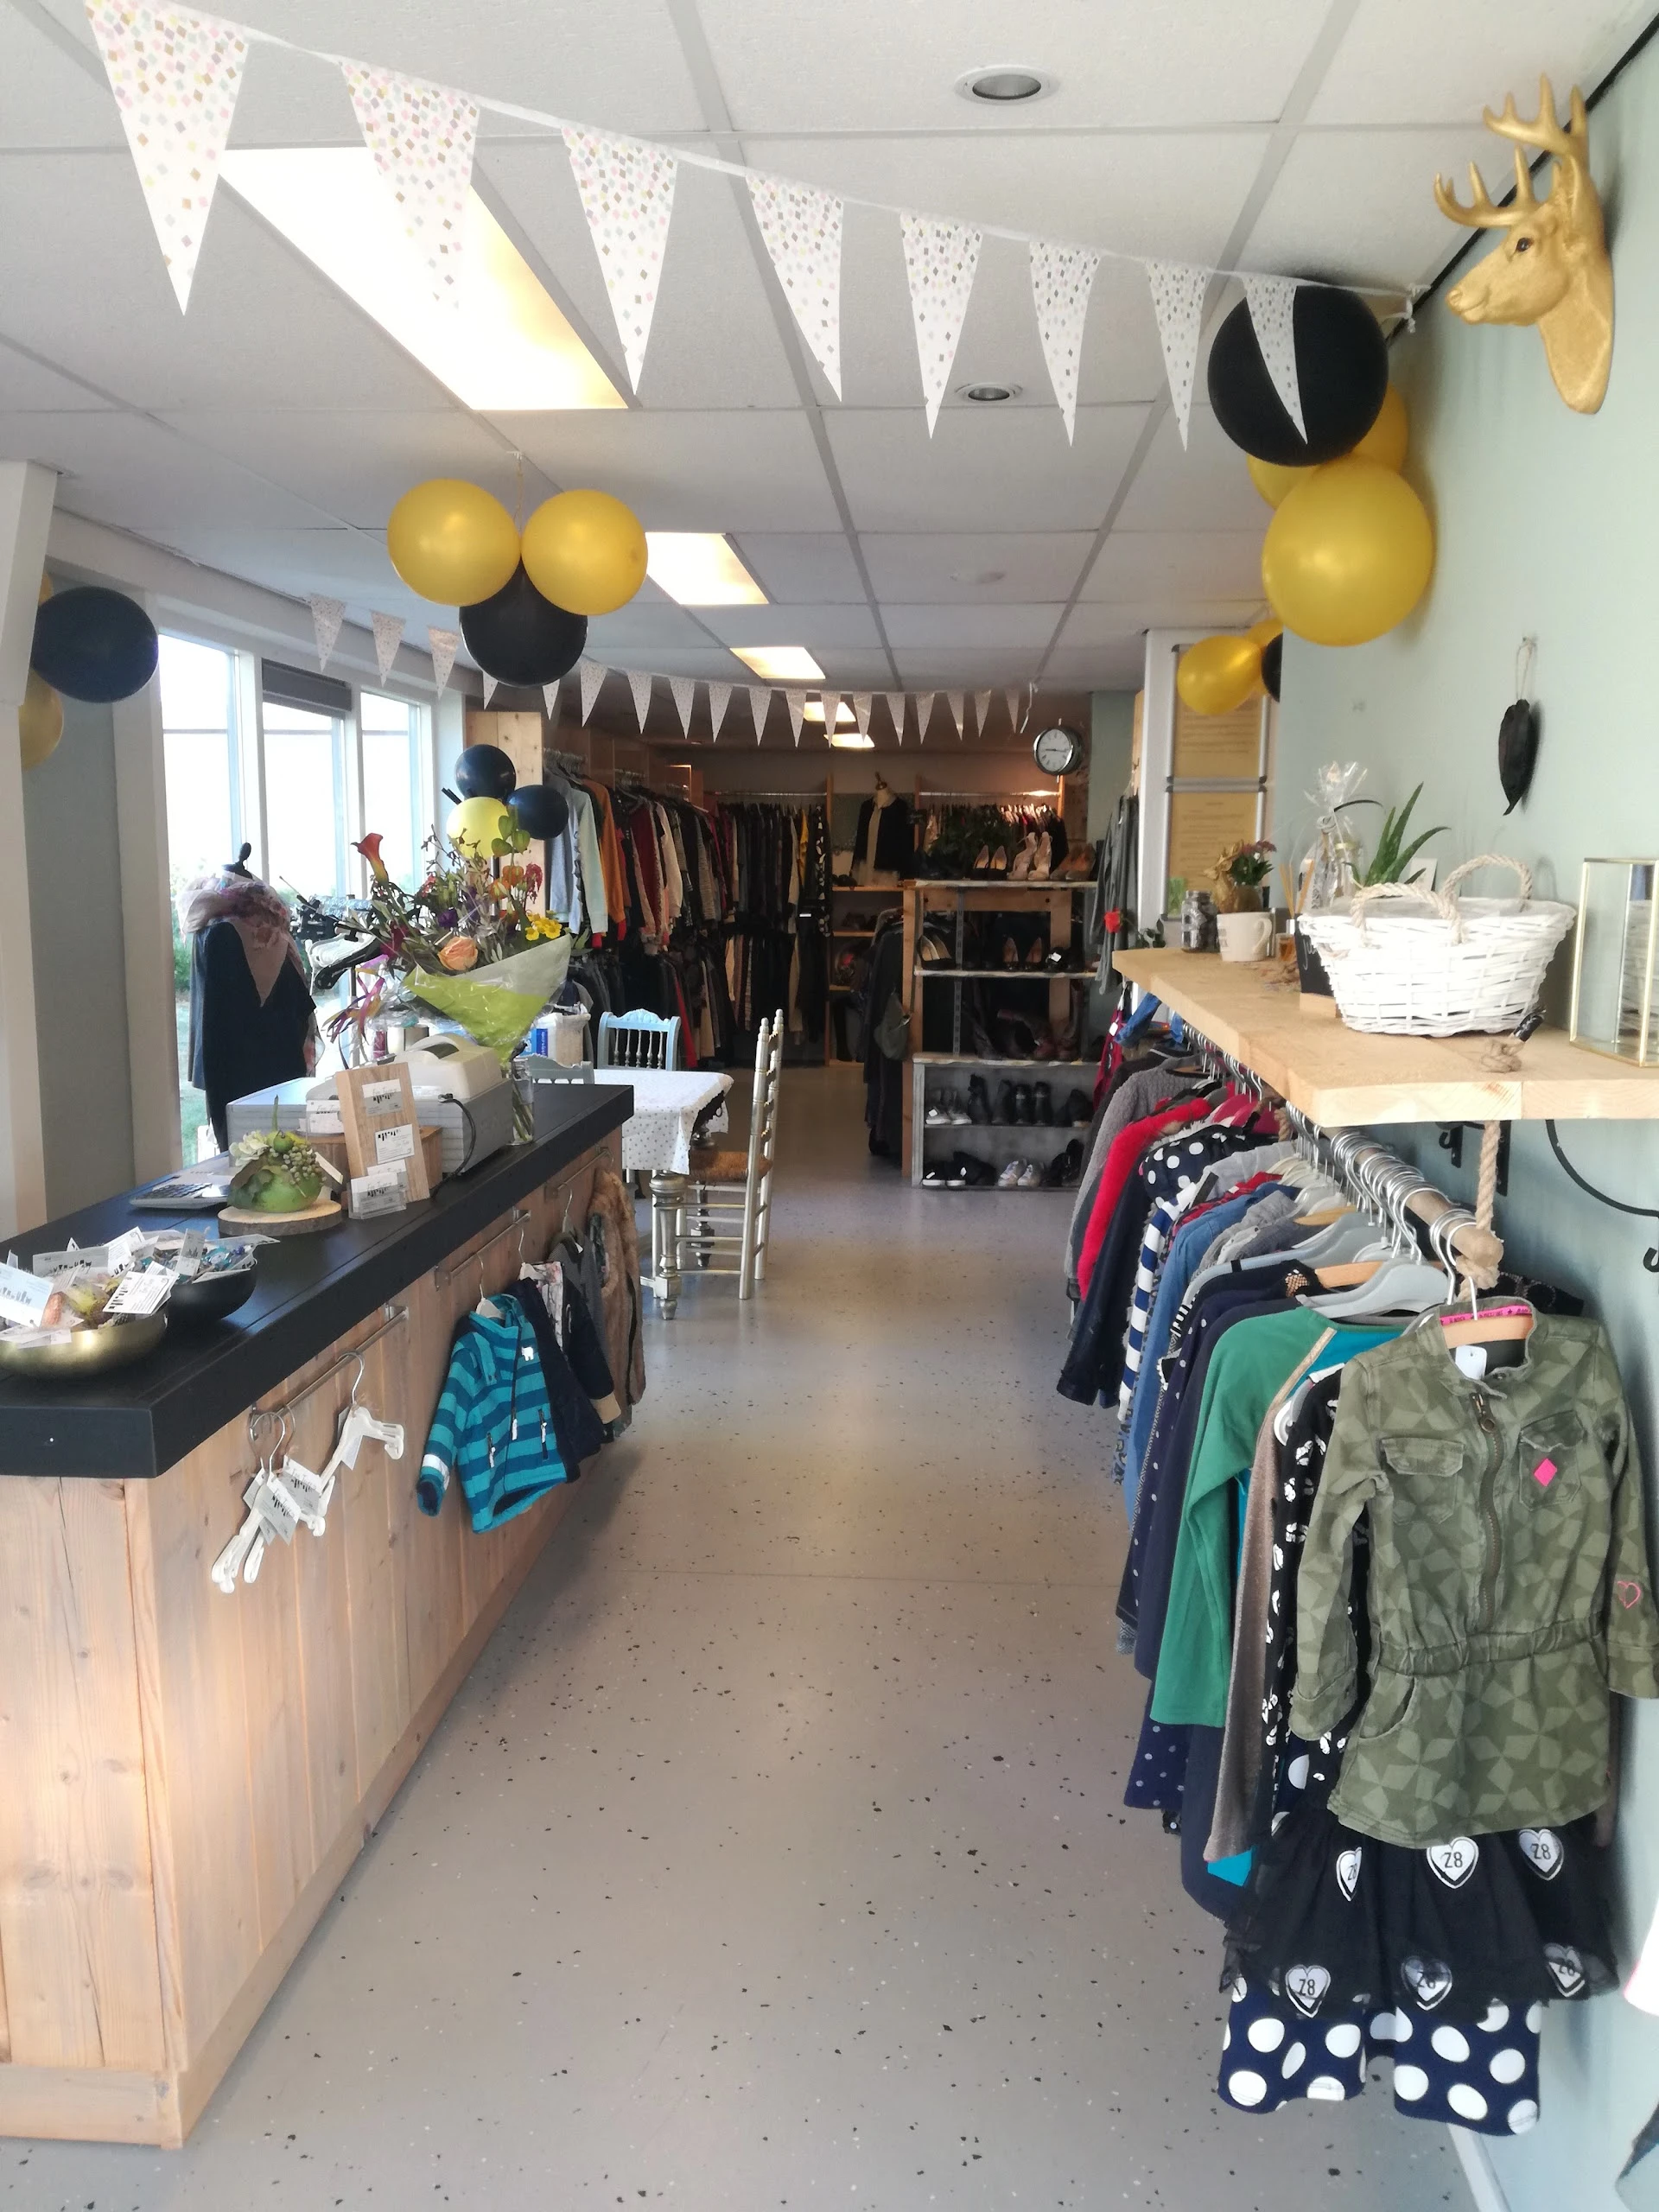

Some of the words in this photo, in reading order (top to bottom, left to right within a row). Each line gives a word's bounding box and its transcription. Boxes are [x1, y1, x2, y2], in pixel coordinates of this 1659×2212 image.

[1442, 1851, 1464, 1869] Z8
[1530, 1843, 1552, 1860] Z8
[1298, 1978, 1316, 1997] Z8
